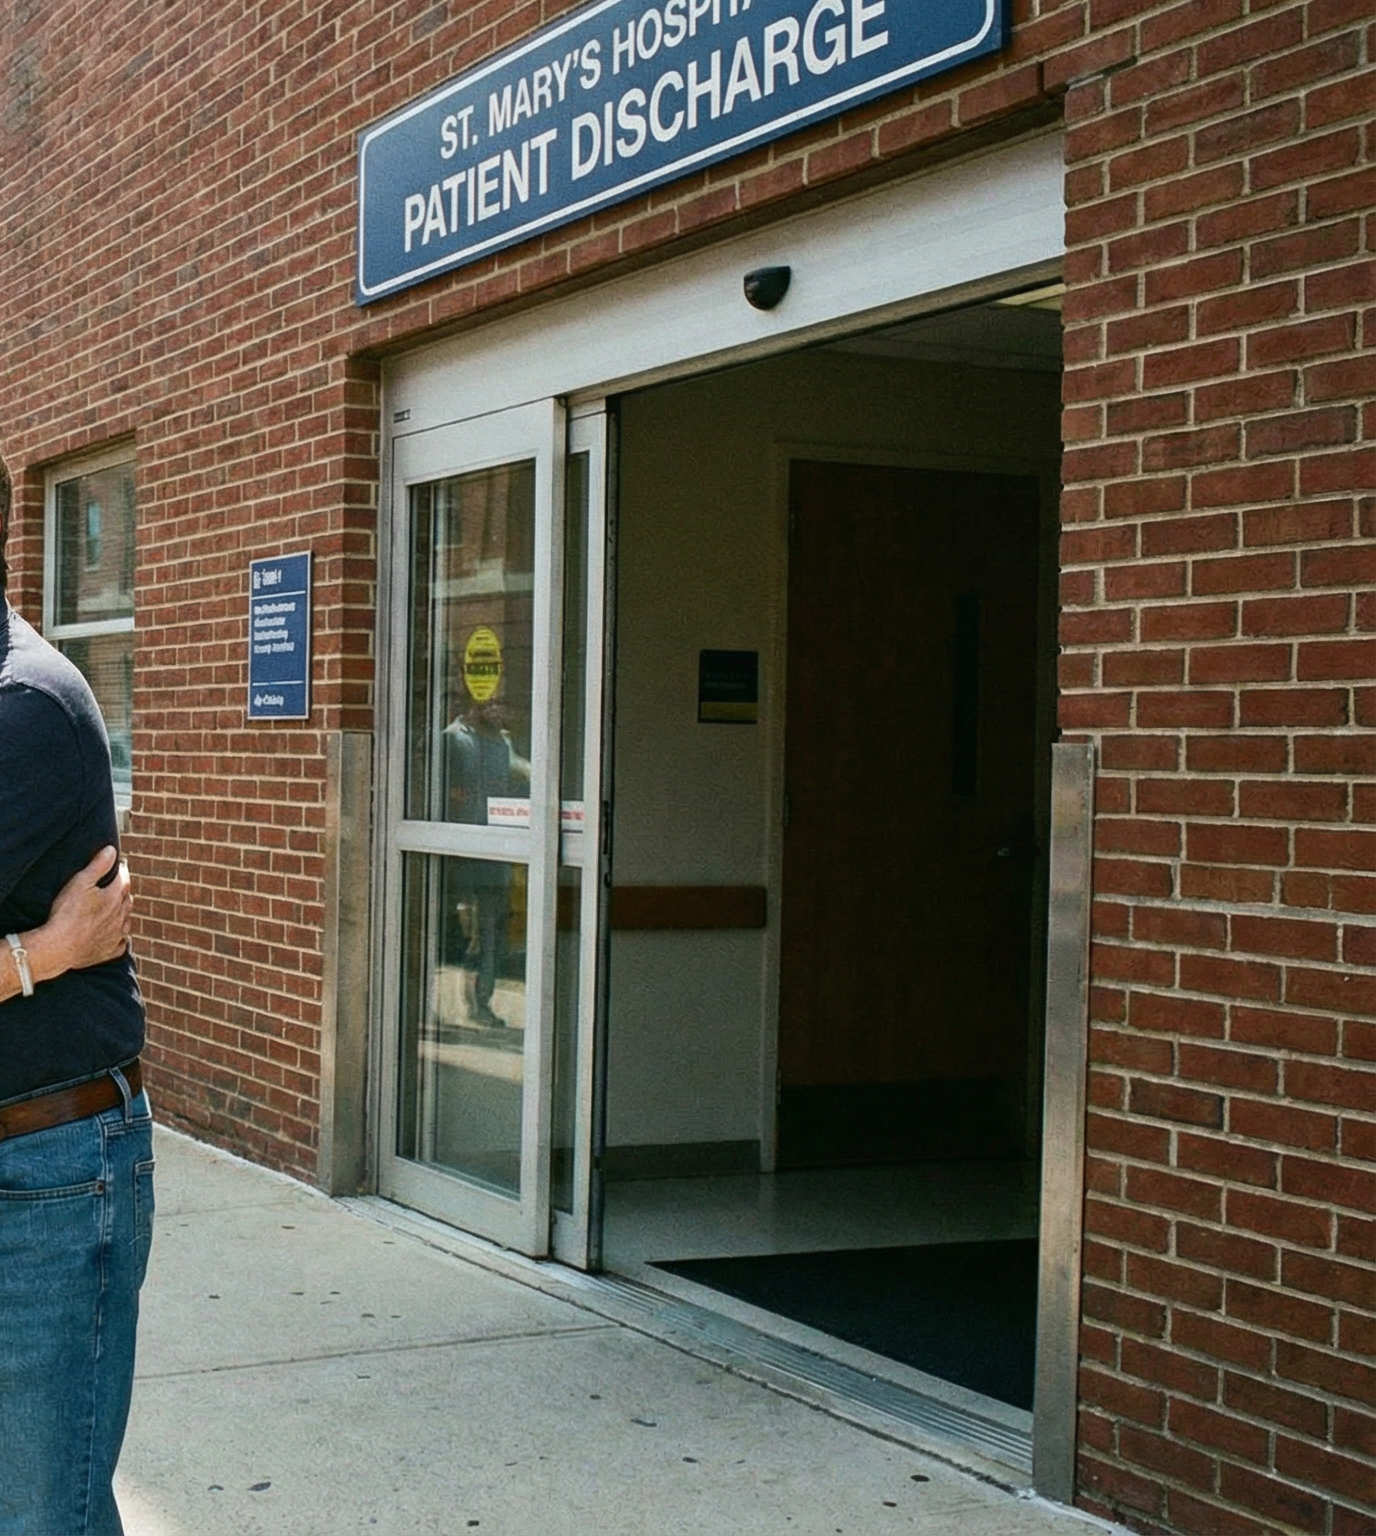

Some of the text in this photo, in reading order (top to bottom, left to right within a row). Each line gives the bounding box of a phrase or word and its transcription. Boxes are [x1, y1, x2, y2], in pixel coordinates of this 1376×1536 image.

[404, 0, 888, 252] PATIENT DISCHARGE
[440, 105, 478, 159] ST.
[488, 39, 601, 136] MARY'S
